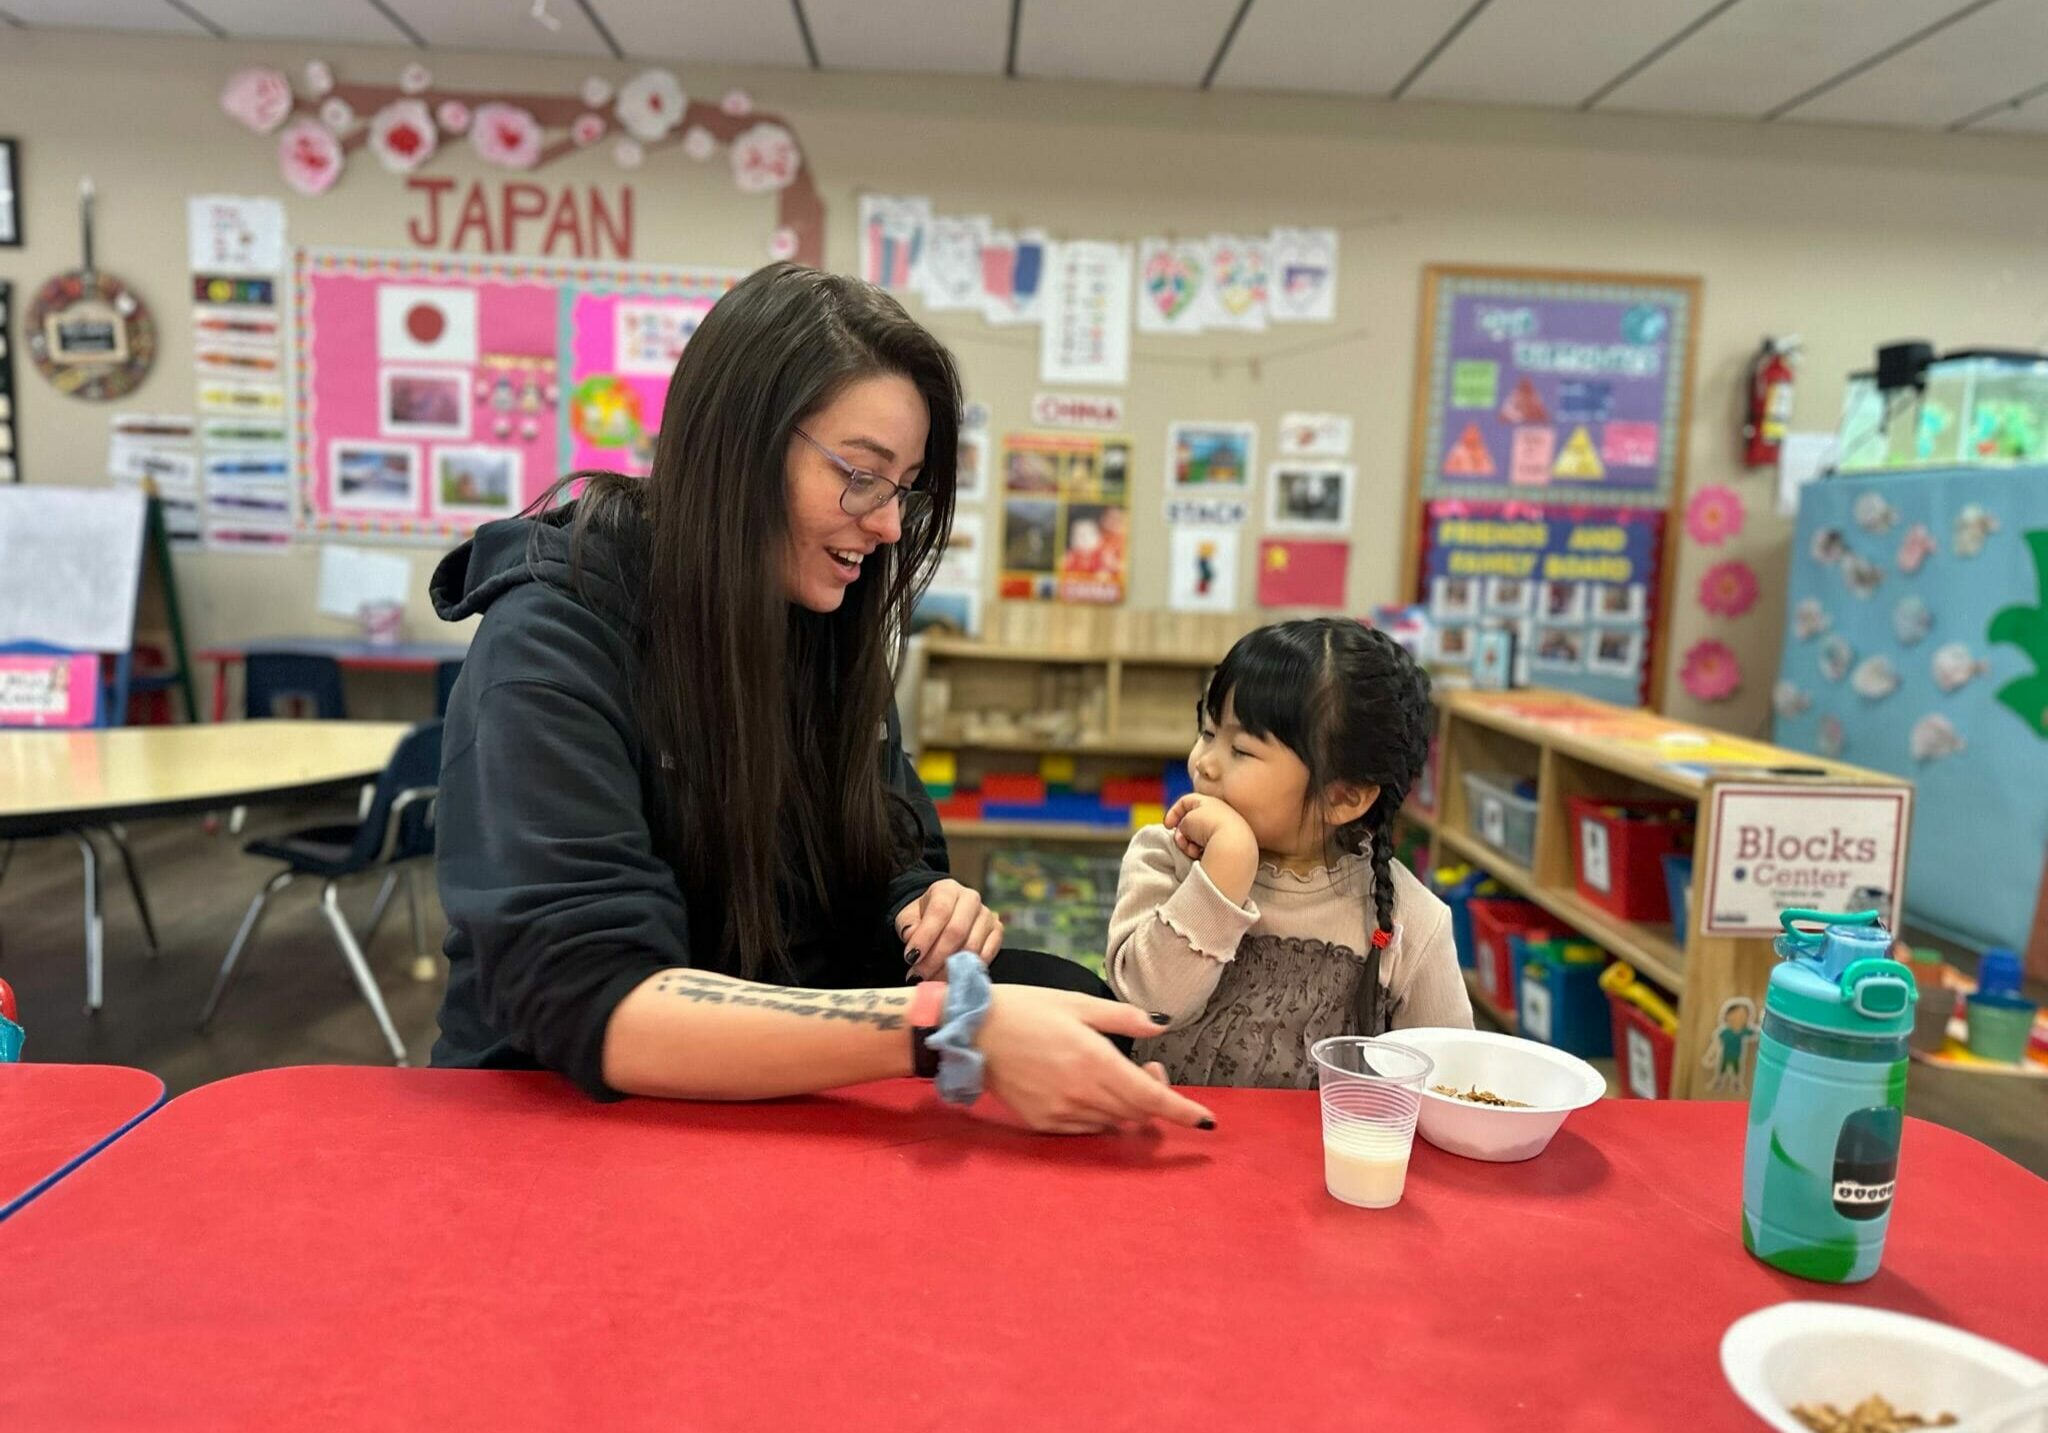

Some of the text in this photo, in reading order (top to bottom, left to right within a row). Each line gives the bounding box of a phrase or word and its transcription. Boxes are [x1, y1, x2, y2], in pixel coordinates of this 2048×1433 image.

[406, 178, 633, 259] JAPAN
[1040, 398, 1116, 422] CHINA
[1437, 520, 1628, 551] FRIENDS AND
[1447, 551, 1633, 582] FAMILY BOARD
[1737, 826, 1876, 862] Blocks
[1753, 864, 1850, 888] Center
